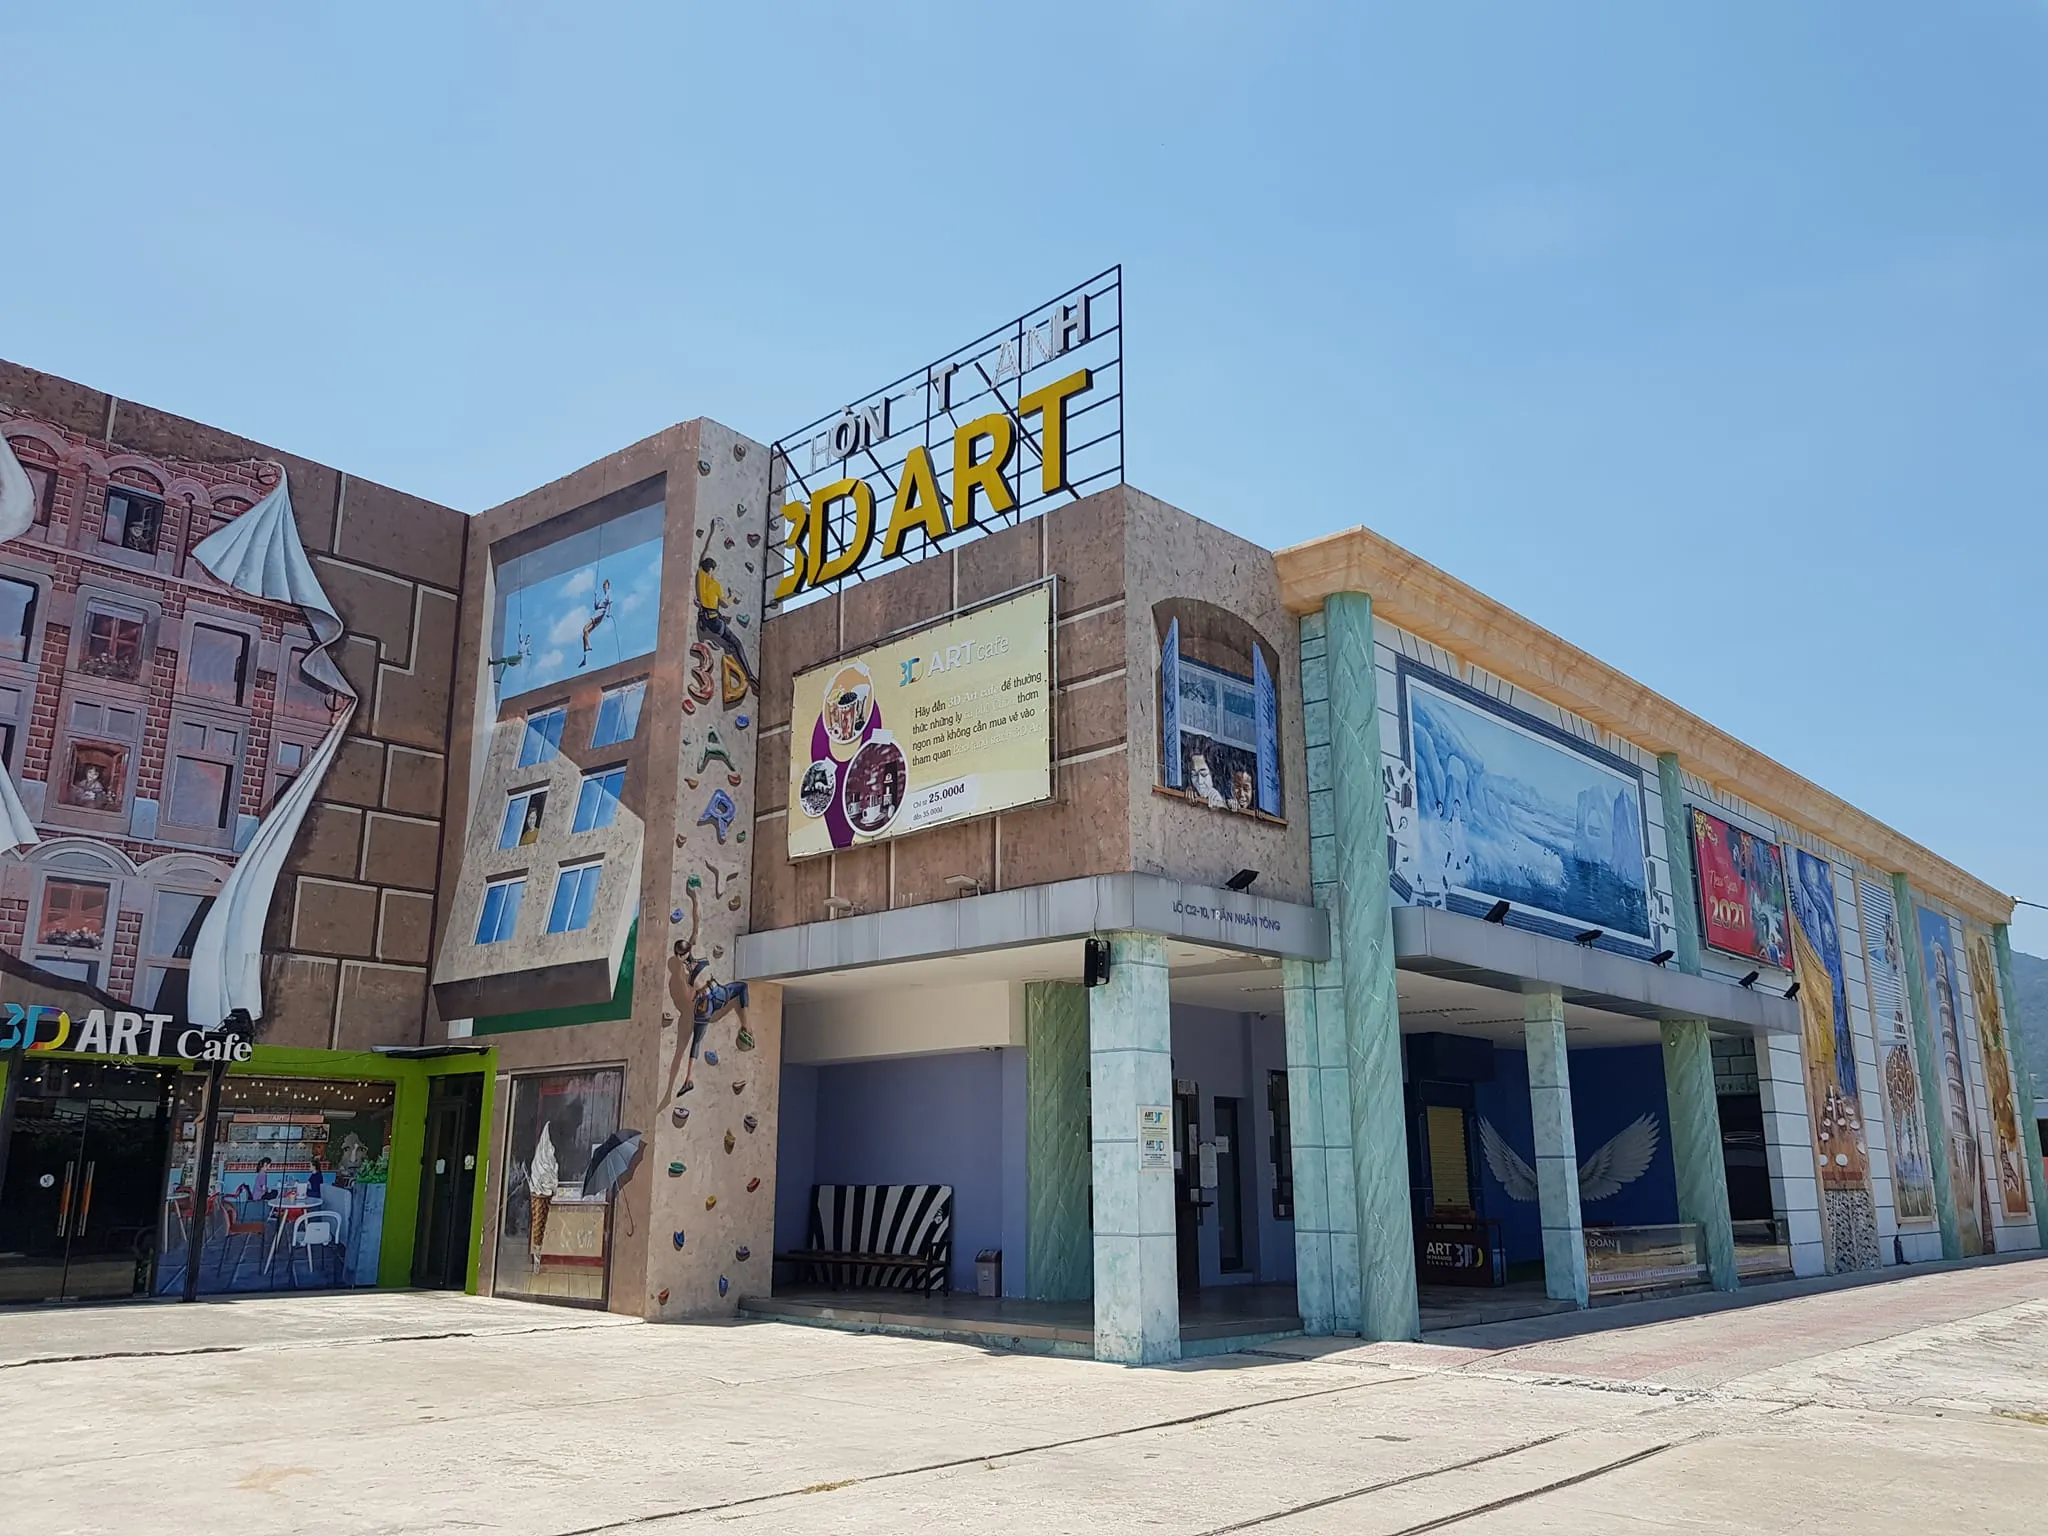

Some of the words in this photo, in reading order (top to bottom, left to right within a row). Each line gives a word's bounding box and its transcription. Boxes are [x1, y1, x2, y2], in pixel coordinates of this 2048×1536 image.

[927, 639, 976, 678] ART
[912, 738, 932, 752] ngon
[989, 717, 1007, 729] mua
[912, 755, 932, 767] tham
[933, 748, 952, 763] quan
[1709, 895, 1746, 930] 2021
[0, 1003, 71, 1050] 3D
[75, 1009, 174, 1057] ART
[177, 1029, 252, 1062] Cafe
[1426, 1242, 1452, 1256] ART
